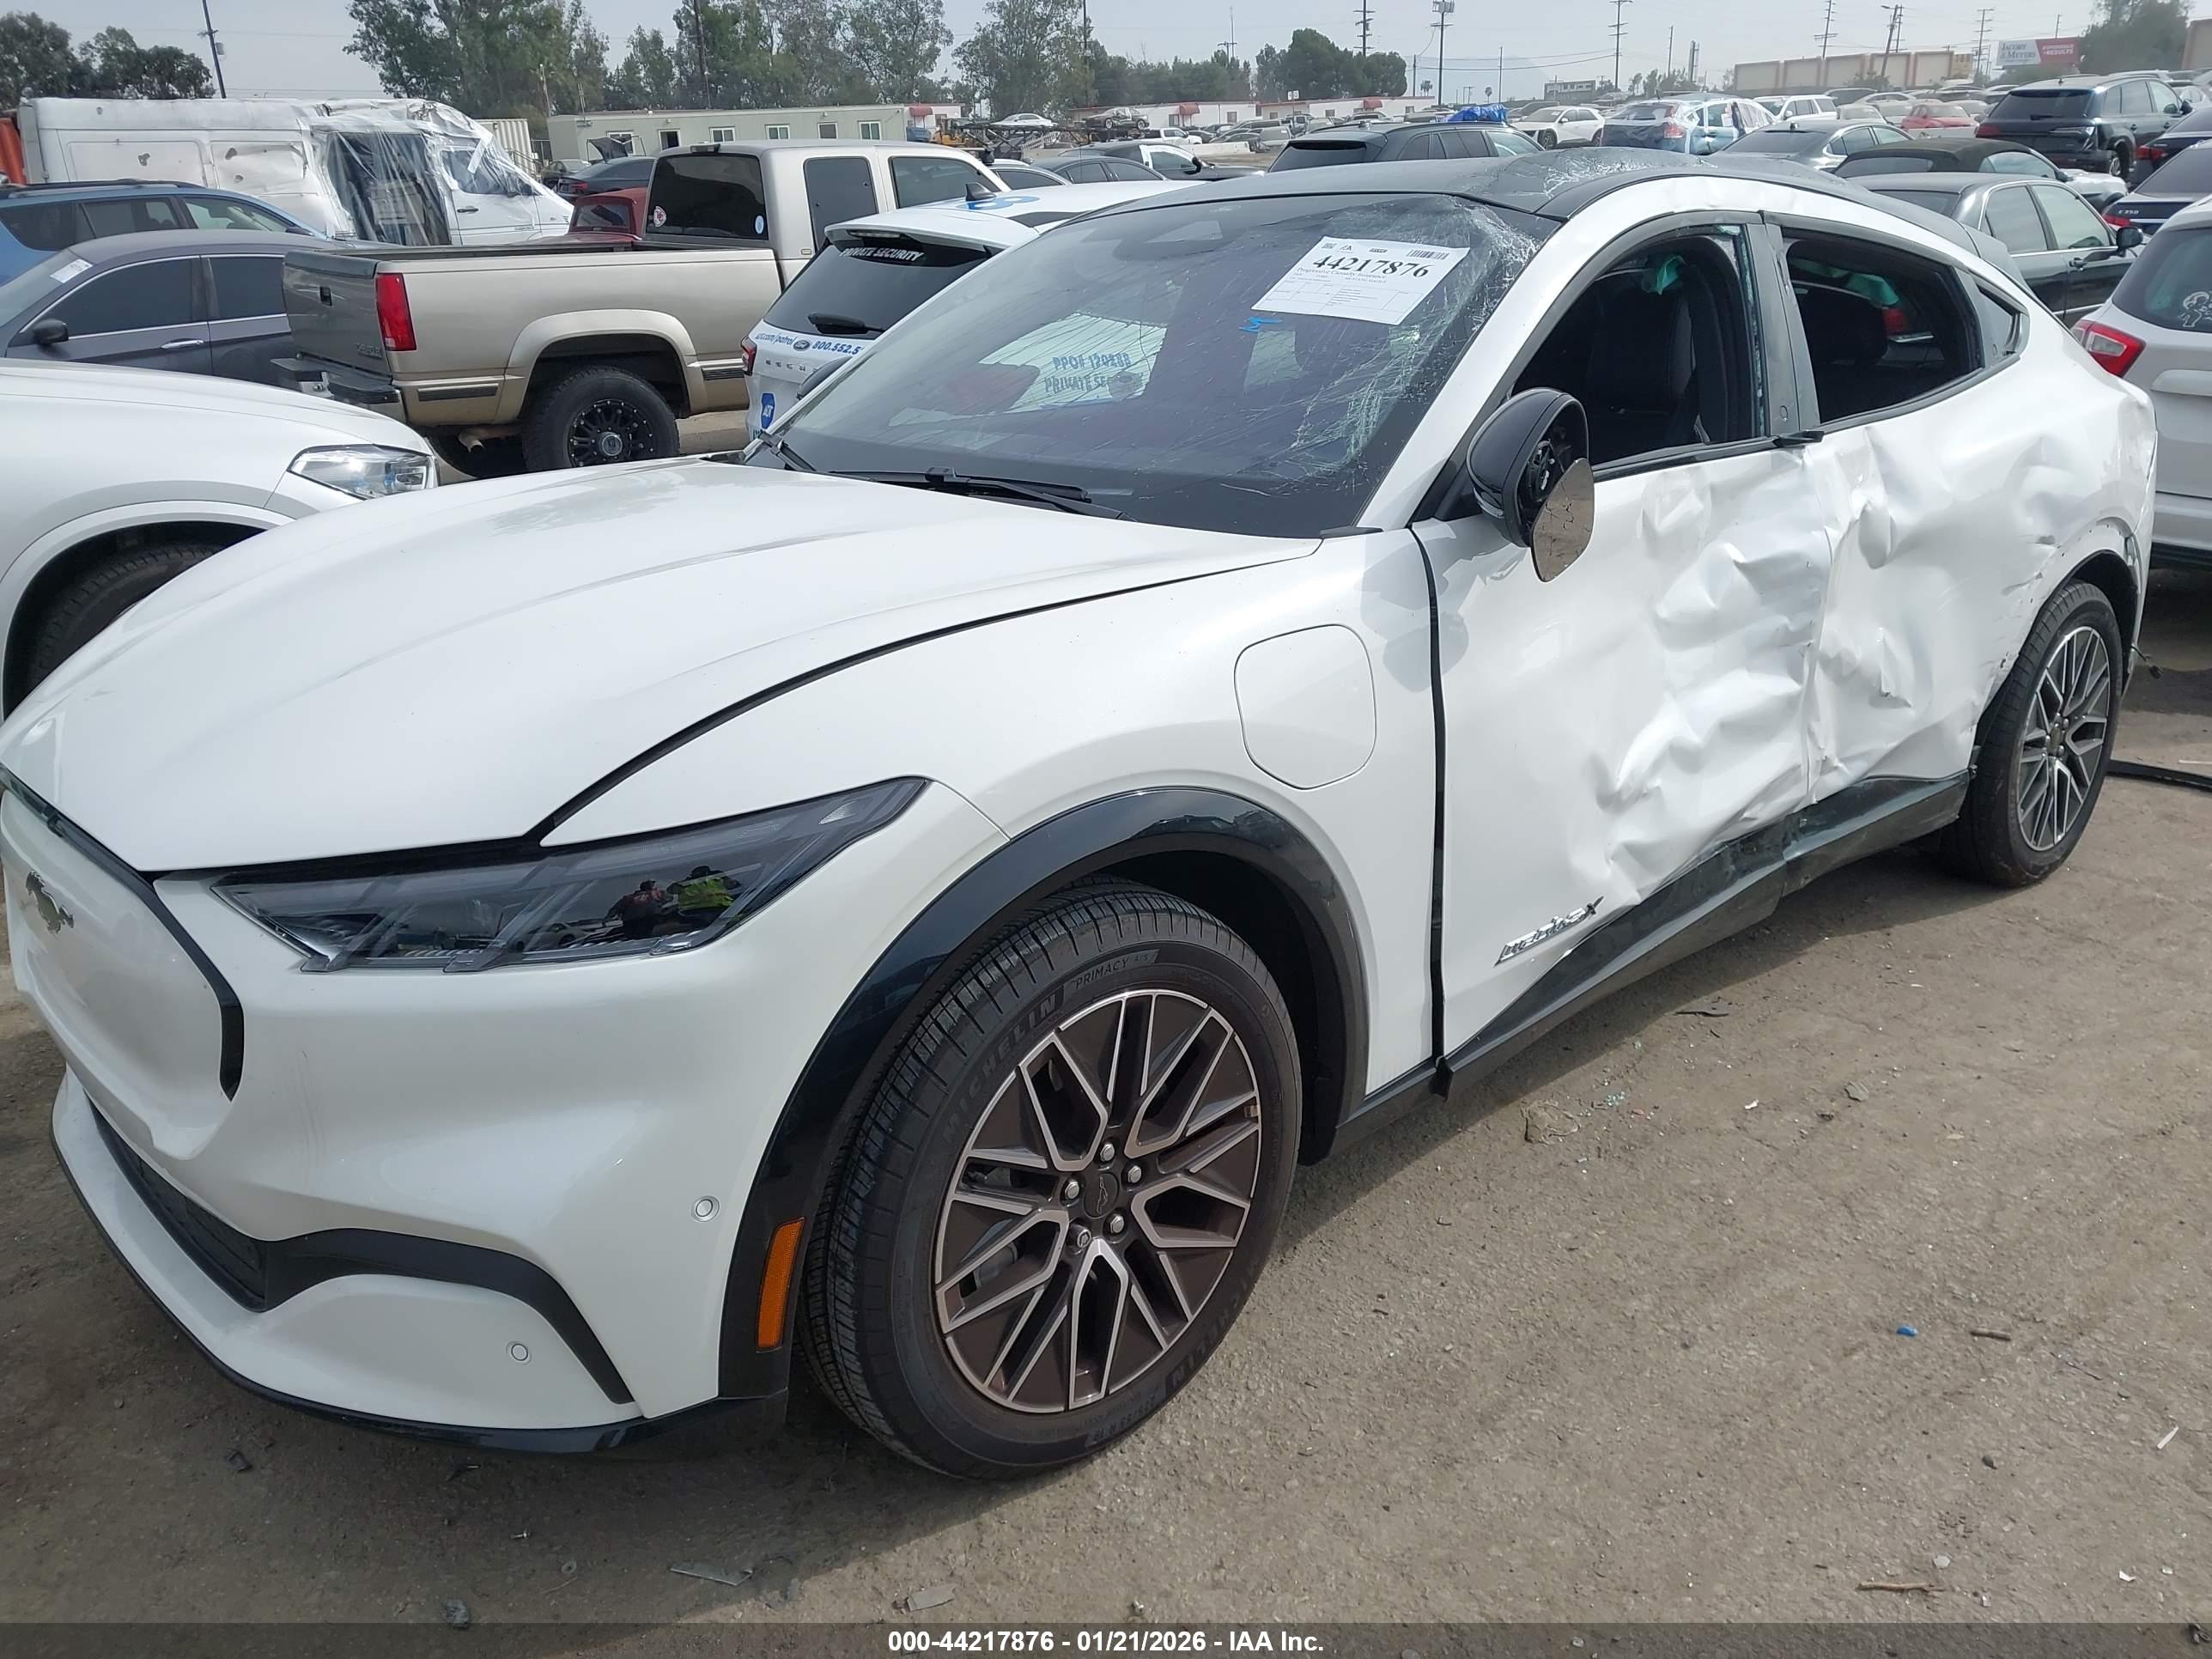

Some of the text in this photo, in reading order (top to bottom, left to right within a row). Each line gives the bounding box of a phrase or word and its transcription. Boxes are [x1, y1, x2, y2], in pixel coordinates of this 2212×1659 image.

[2002, 42, 2027, 51] JACOBY
[2006, 50, 2035, 59] MEYERS
[839, 246, 925, 262] PRIVATE SECURITY
[1313, 255, 1435, 278] 44217876
[811, 341, 865, 356] 800.552.5
[941, 993, 1056, 1146] MICHELIN
[1071, 956, 1129, 990] PRIMACY
